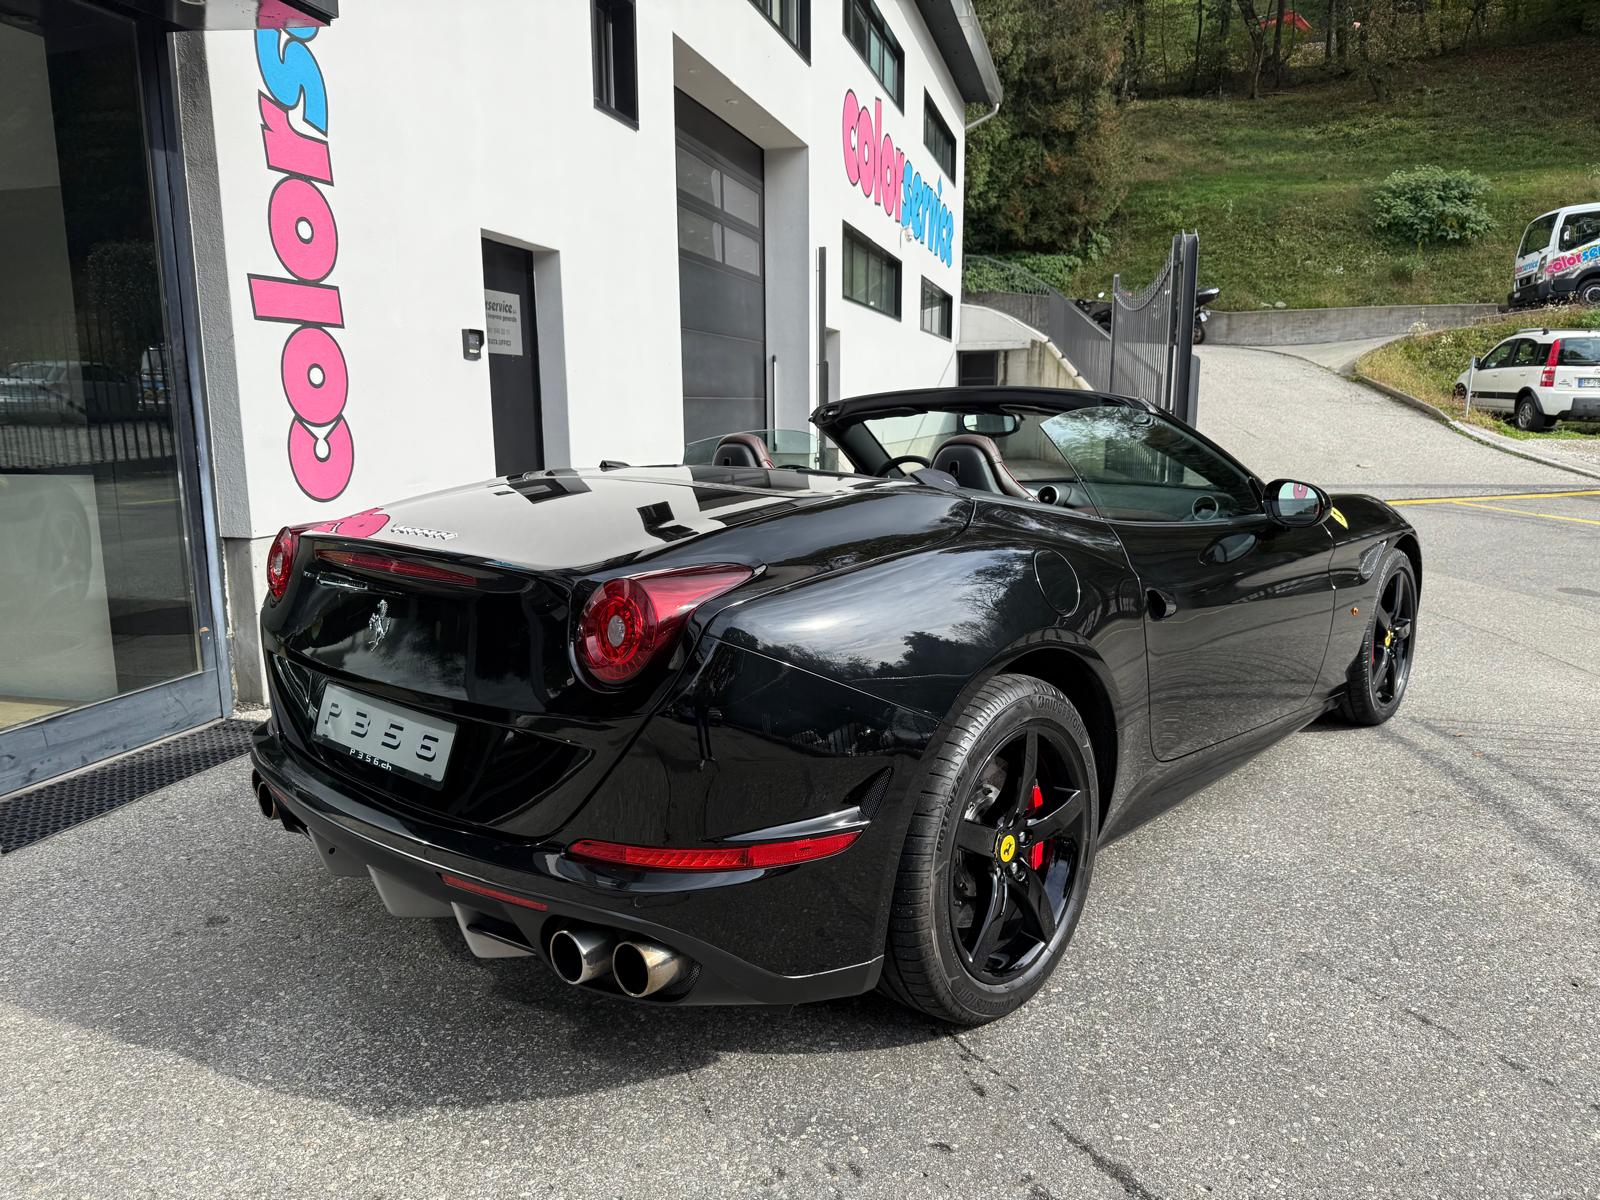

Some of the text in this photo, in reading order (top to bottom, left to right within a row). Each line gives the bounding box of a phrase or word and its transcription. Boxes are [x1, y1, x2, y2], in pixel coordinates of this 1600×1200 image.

[842, 88, 954, 268] colorservice
[247, 27, 355, 503] colors
[1038, 695, 1086, 738] BRIDGESTONE
[935, 773, 963, 853] POTENZA
